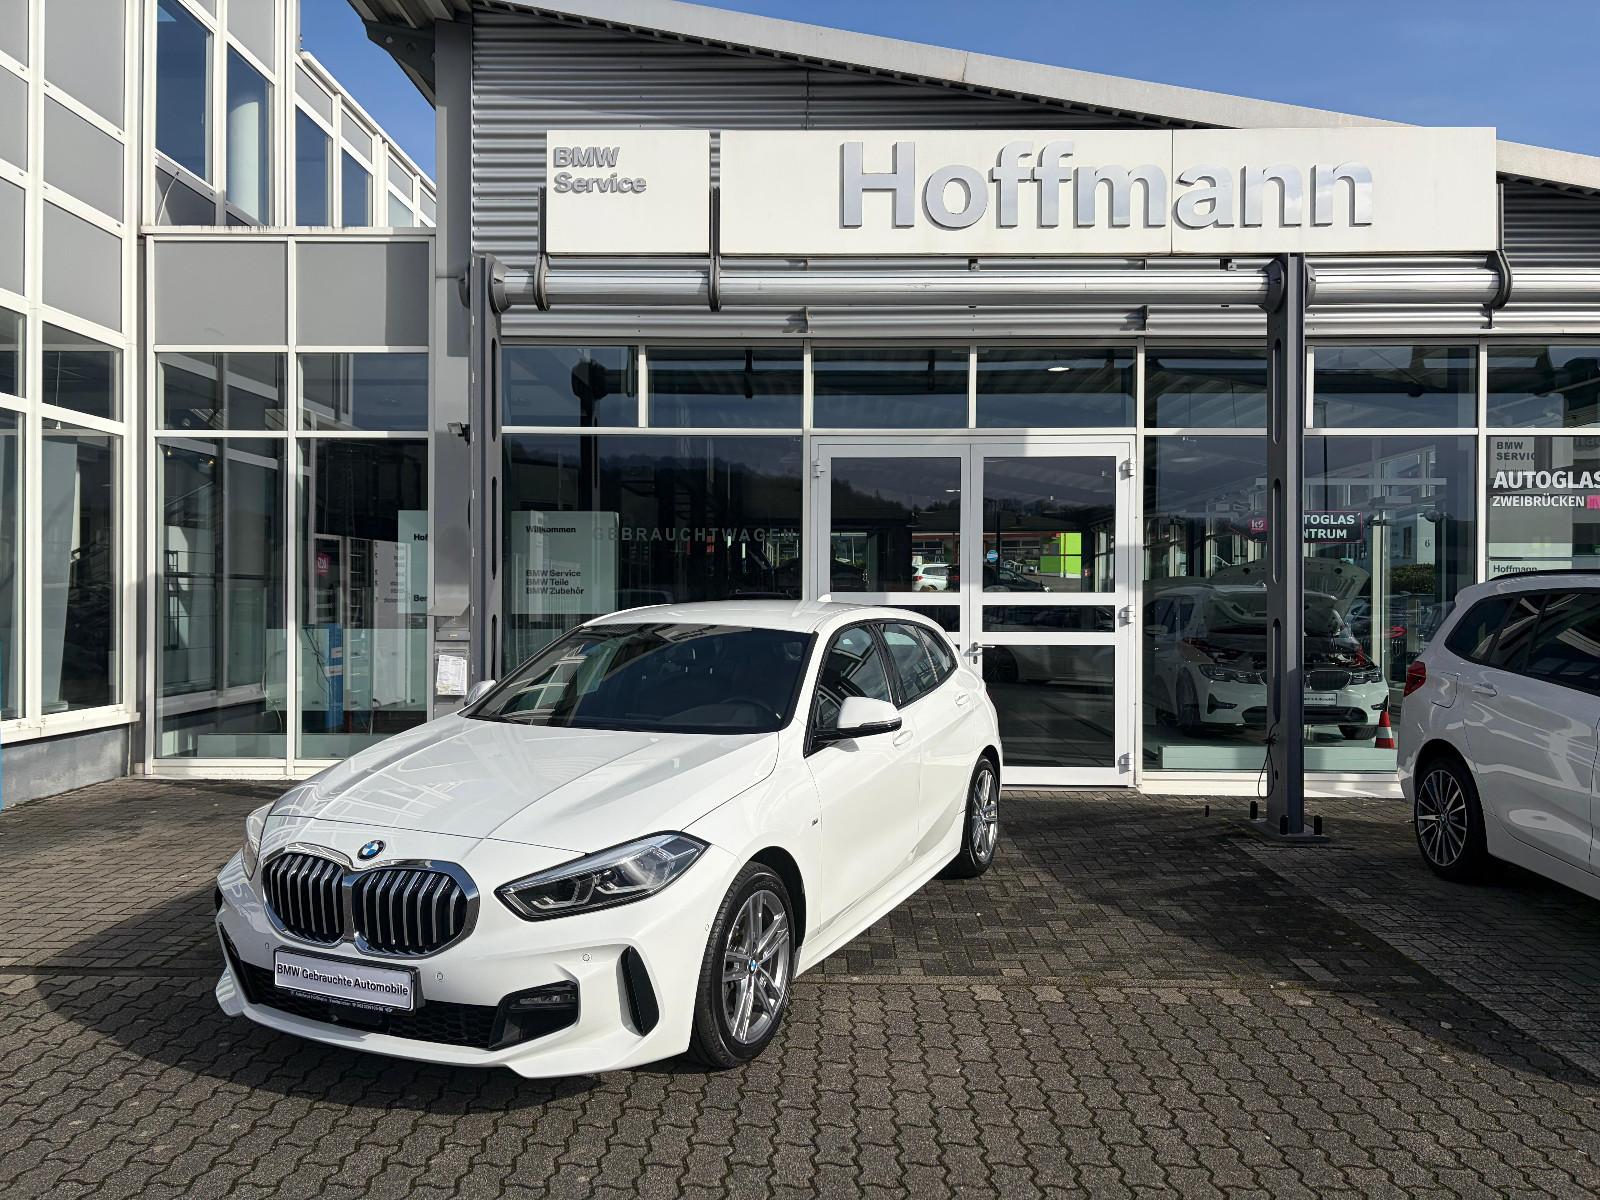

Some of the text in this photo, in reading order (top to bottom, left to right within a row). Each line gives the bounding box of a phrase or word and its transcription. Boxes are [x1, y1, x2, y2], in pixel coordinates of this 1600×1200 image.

[553, 146, 620, 168] BMW
[553, 171, 647, 194] Service
[838, 141, 1373, 229] Hoffmann
[1496, 441, 1524, 450] BMW
[1492, 492, 1585, 507] ZWEIBRÜCKEN
[526, 525, 576, 533] Willkommen
[550, 569, 581, 577] Service
[550, 586, 584, 595] Zubehör
[277, 963, 409, 996] BMW Gebrauchte Automobile
